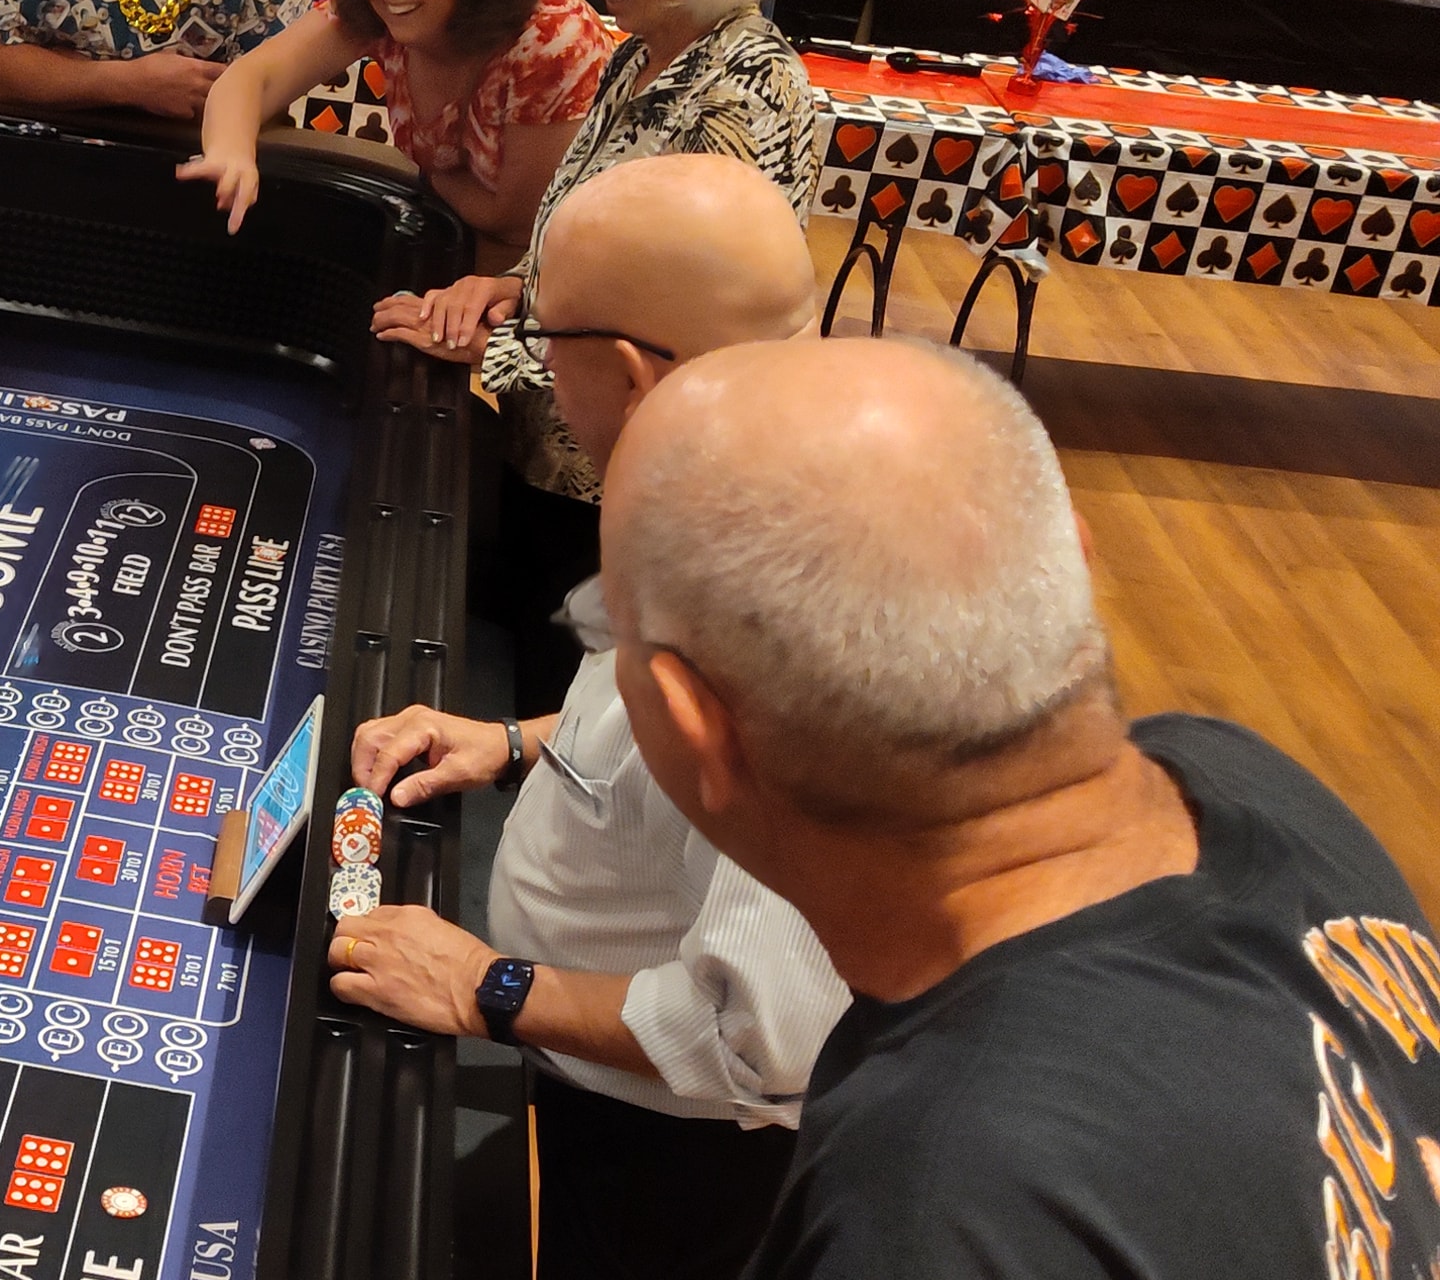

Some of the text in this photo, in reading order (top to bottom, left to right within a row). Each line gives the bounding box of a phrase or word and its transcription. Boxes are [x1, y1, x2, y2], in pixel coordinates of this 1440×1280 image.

[25, 417, 69, 432] PASS
[71, 425, 132, 442] DON'T
[118, 505, 159, 524] 12
[112, 553, 152, 596] FIELD
[160, 543, 222, 668] DON'T PASS BAR
[231, 579, 280, 631] PASS
[295, 533, 346, 669] CASINO PARTY USA
[73, 631, 109, 644] 2
[153, 848, 187, 900] HORN
